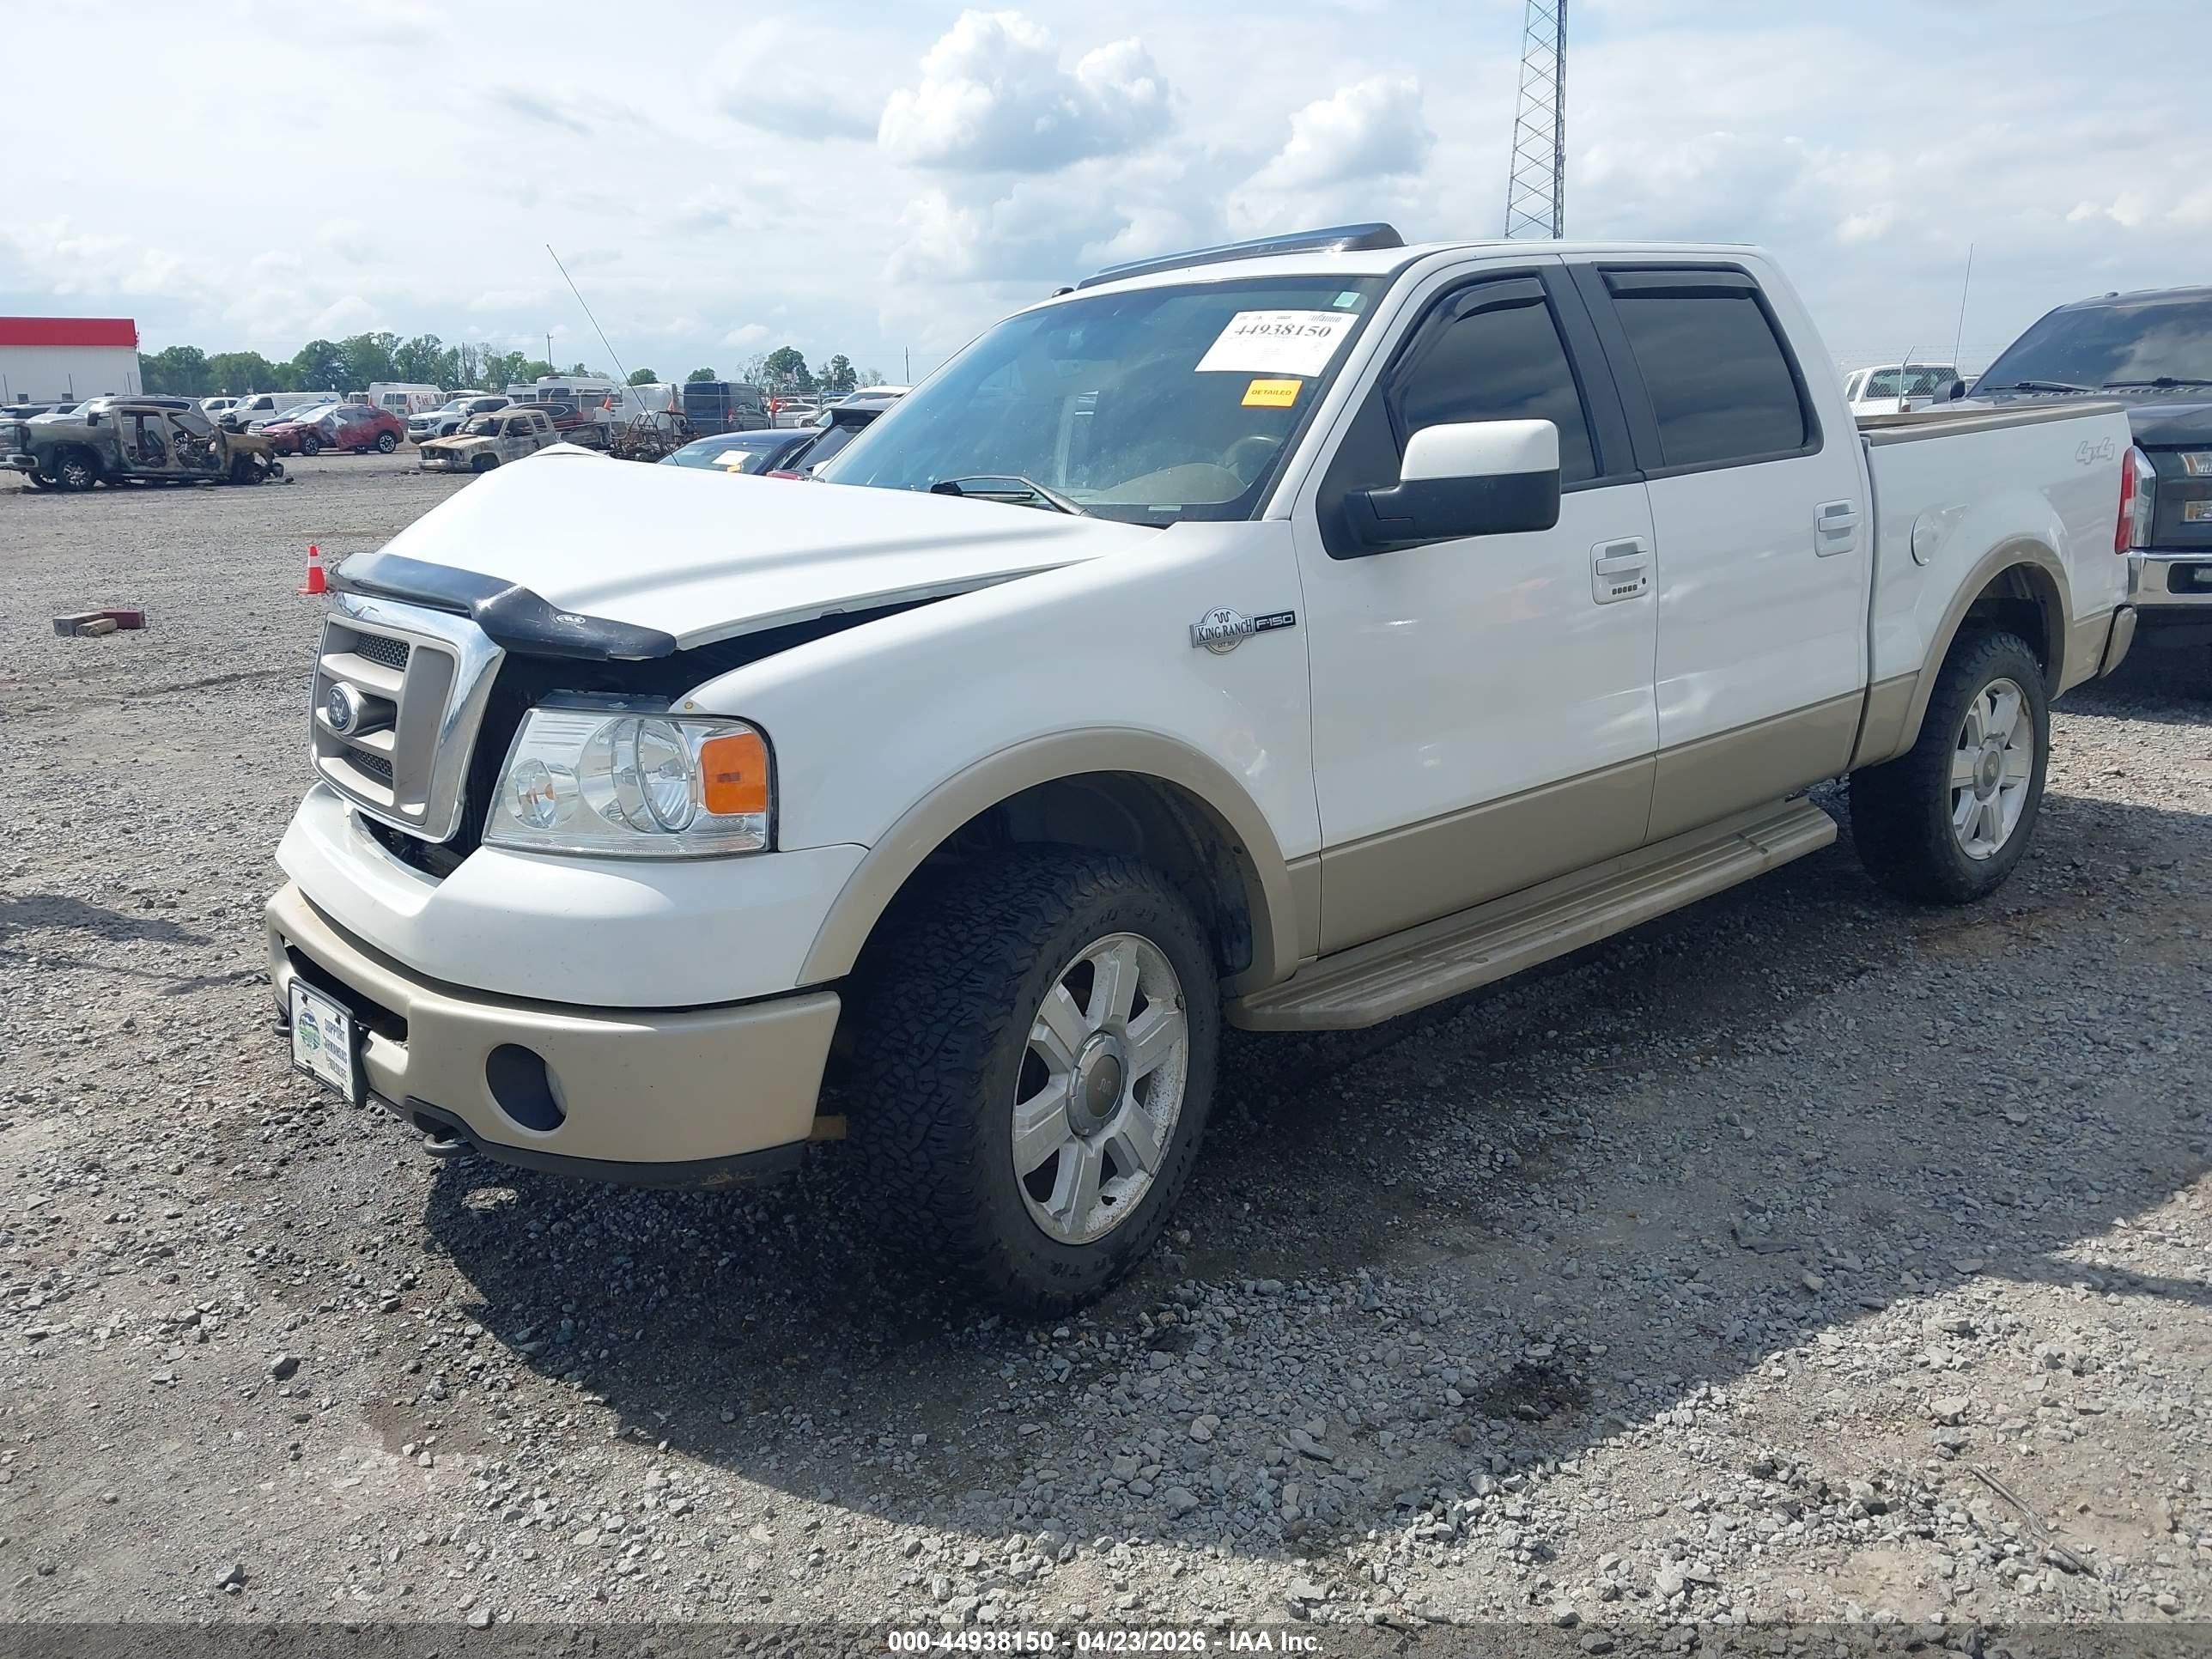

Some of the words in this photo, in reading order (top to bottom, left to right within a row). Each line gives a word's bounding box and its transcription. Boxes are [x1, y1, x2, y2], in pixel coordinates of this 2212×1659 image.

[1235, 323, 1332, 338] 44938150
[2075, 438, 2115, 465] 4x4
[1197, 624, 1221, 641] KING
[1223, 618, 1253, 638] RANCH
